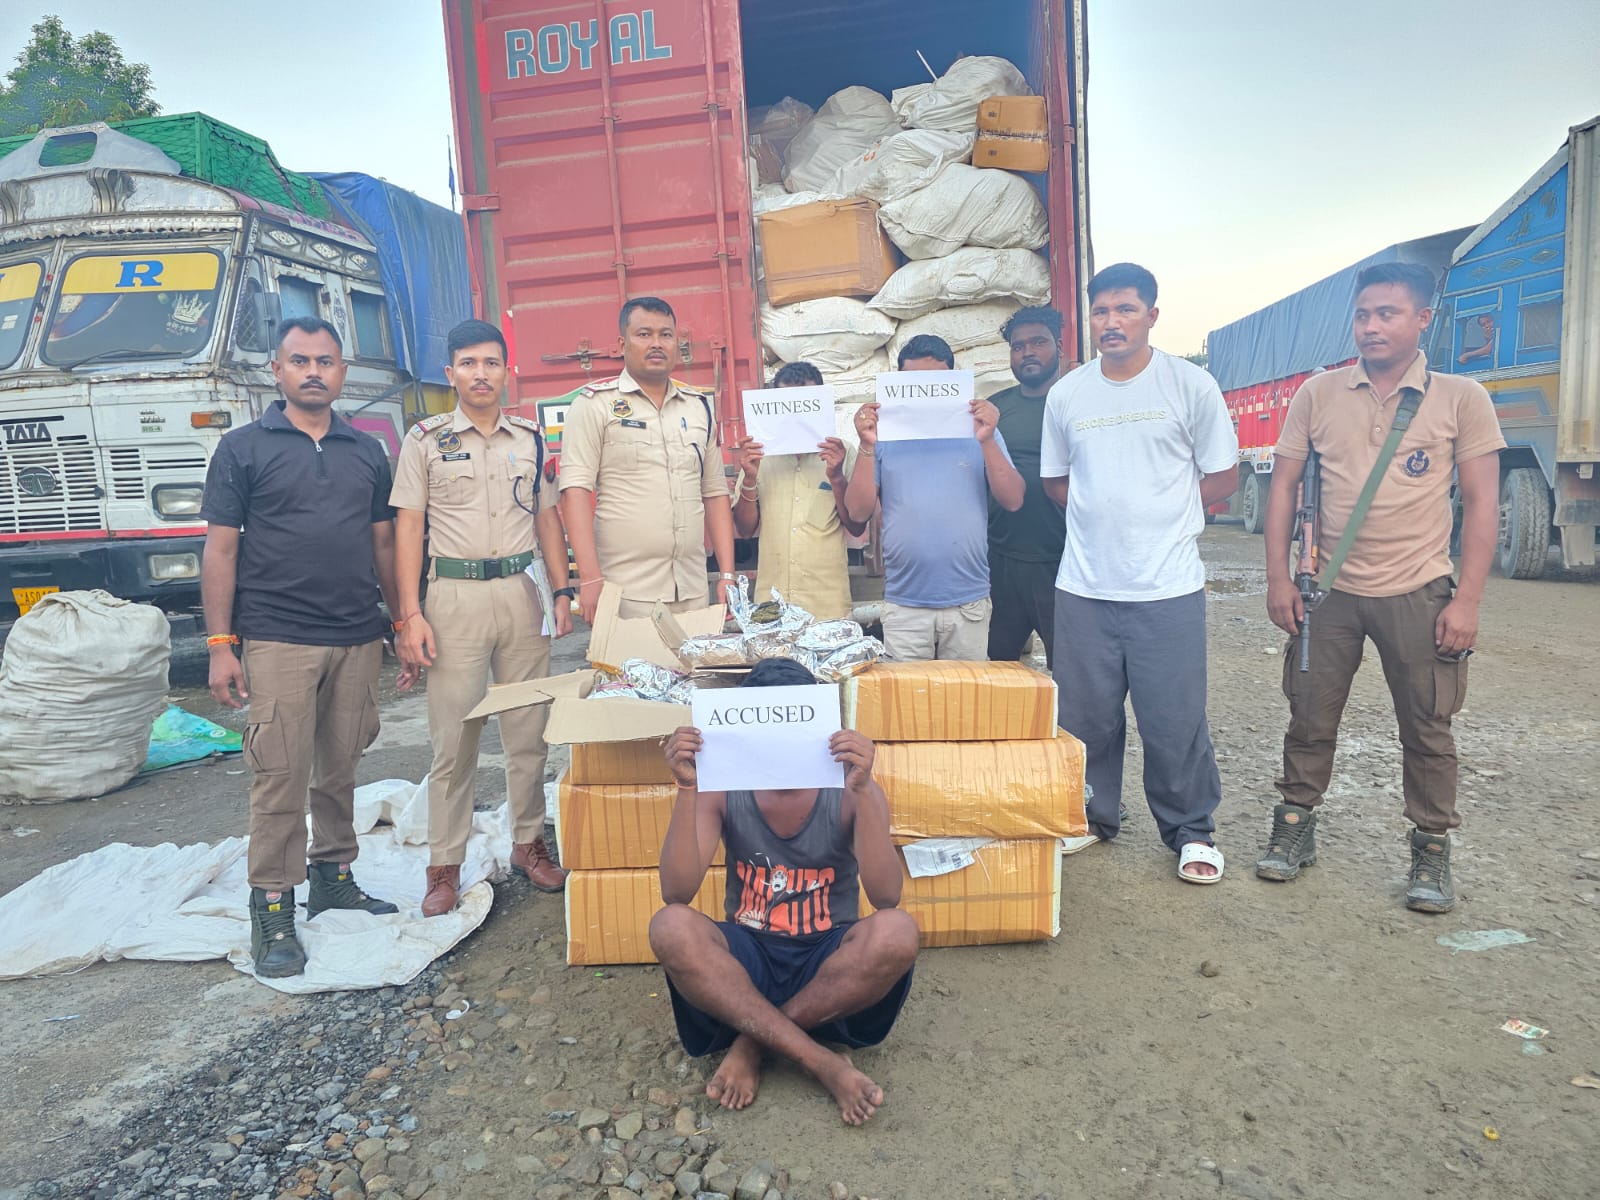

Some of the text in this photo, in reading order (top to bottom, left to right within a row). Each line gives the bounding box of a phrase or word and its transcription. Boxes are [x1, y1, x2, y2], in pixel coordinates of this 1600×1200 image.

[505, 9, 672, 80] ROYAL
[115, 260, 164, 288] R
[885, 383, 960, 399] WITNESS
[751, 399, 821, 416] WITNESS
[2, 422, 52, 441] TATA
[708, 704, 816, 726] ACCUSED
